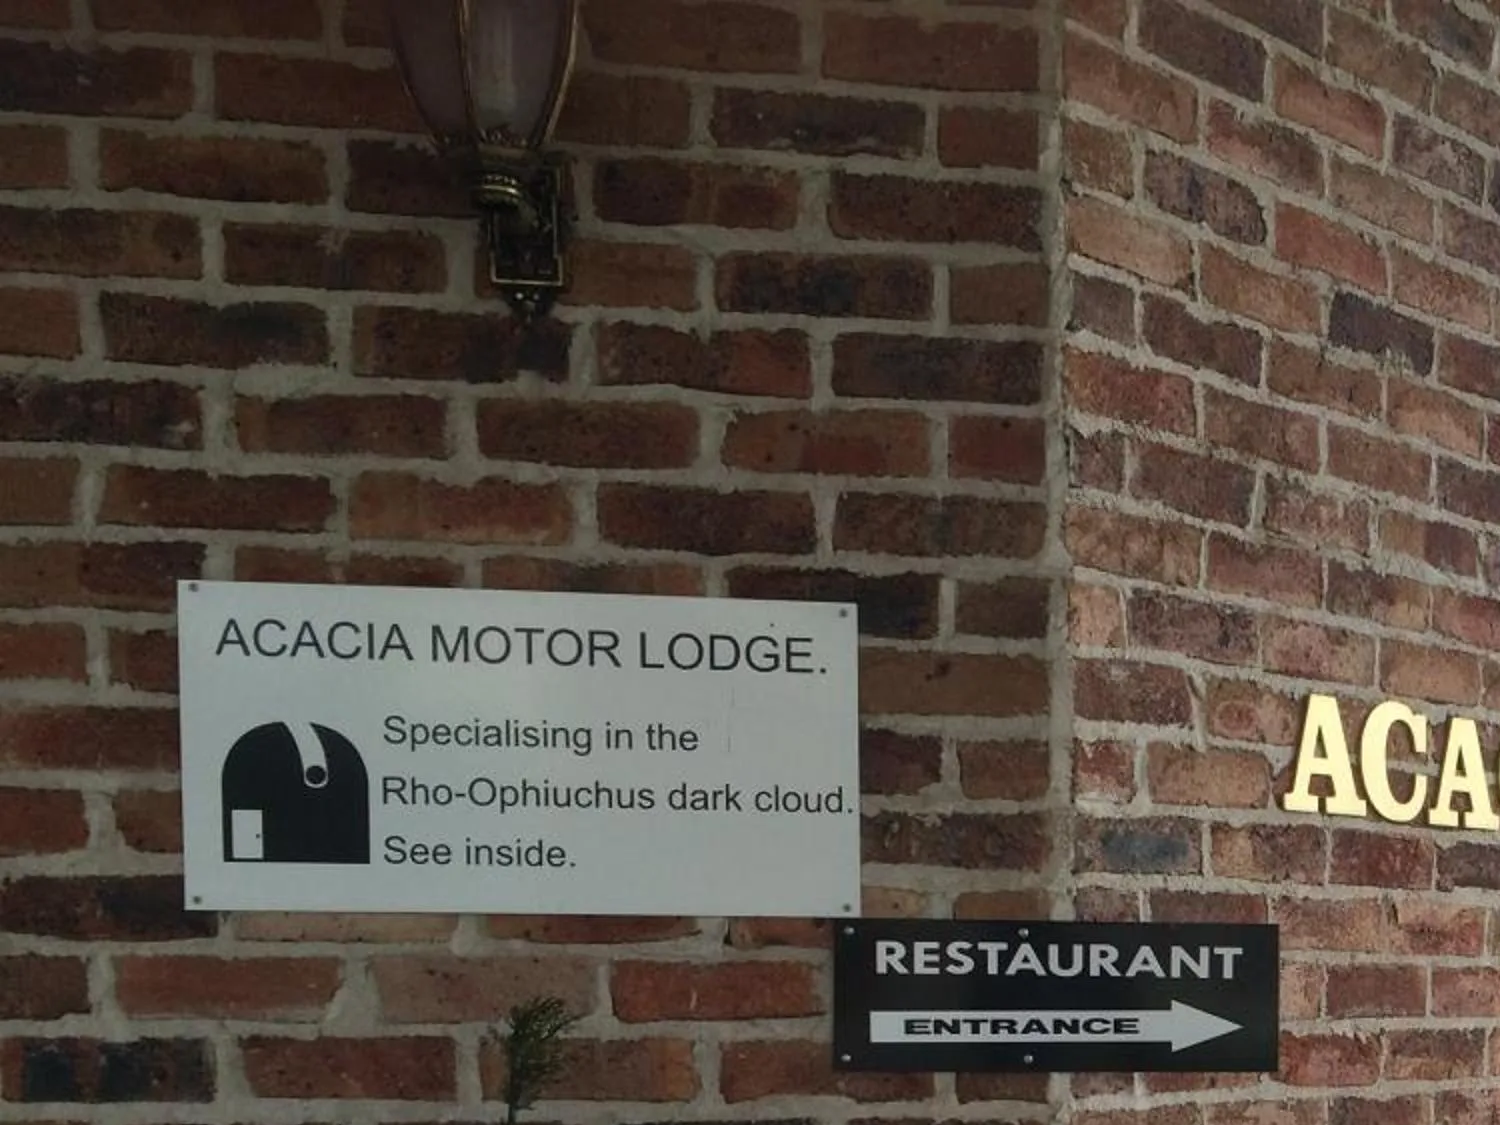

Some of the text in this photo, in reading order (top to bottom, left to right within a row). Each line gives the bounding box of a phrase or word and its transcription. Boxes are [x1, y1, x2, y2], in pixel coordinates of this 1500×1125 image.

[214, 618, 828, 675] ACACIA MOTOR LODGE.
[383, 716, 699, 756] Specialising in the
[382, 776, 853, 817] Rho-Ophiuchus dark cloud.
[383, 836, 576, 869] See inside.
[876, 940, 1243, 979] RESTAURANT
[904, 1017, 1140, 1036] ENTRANCE
